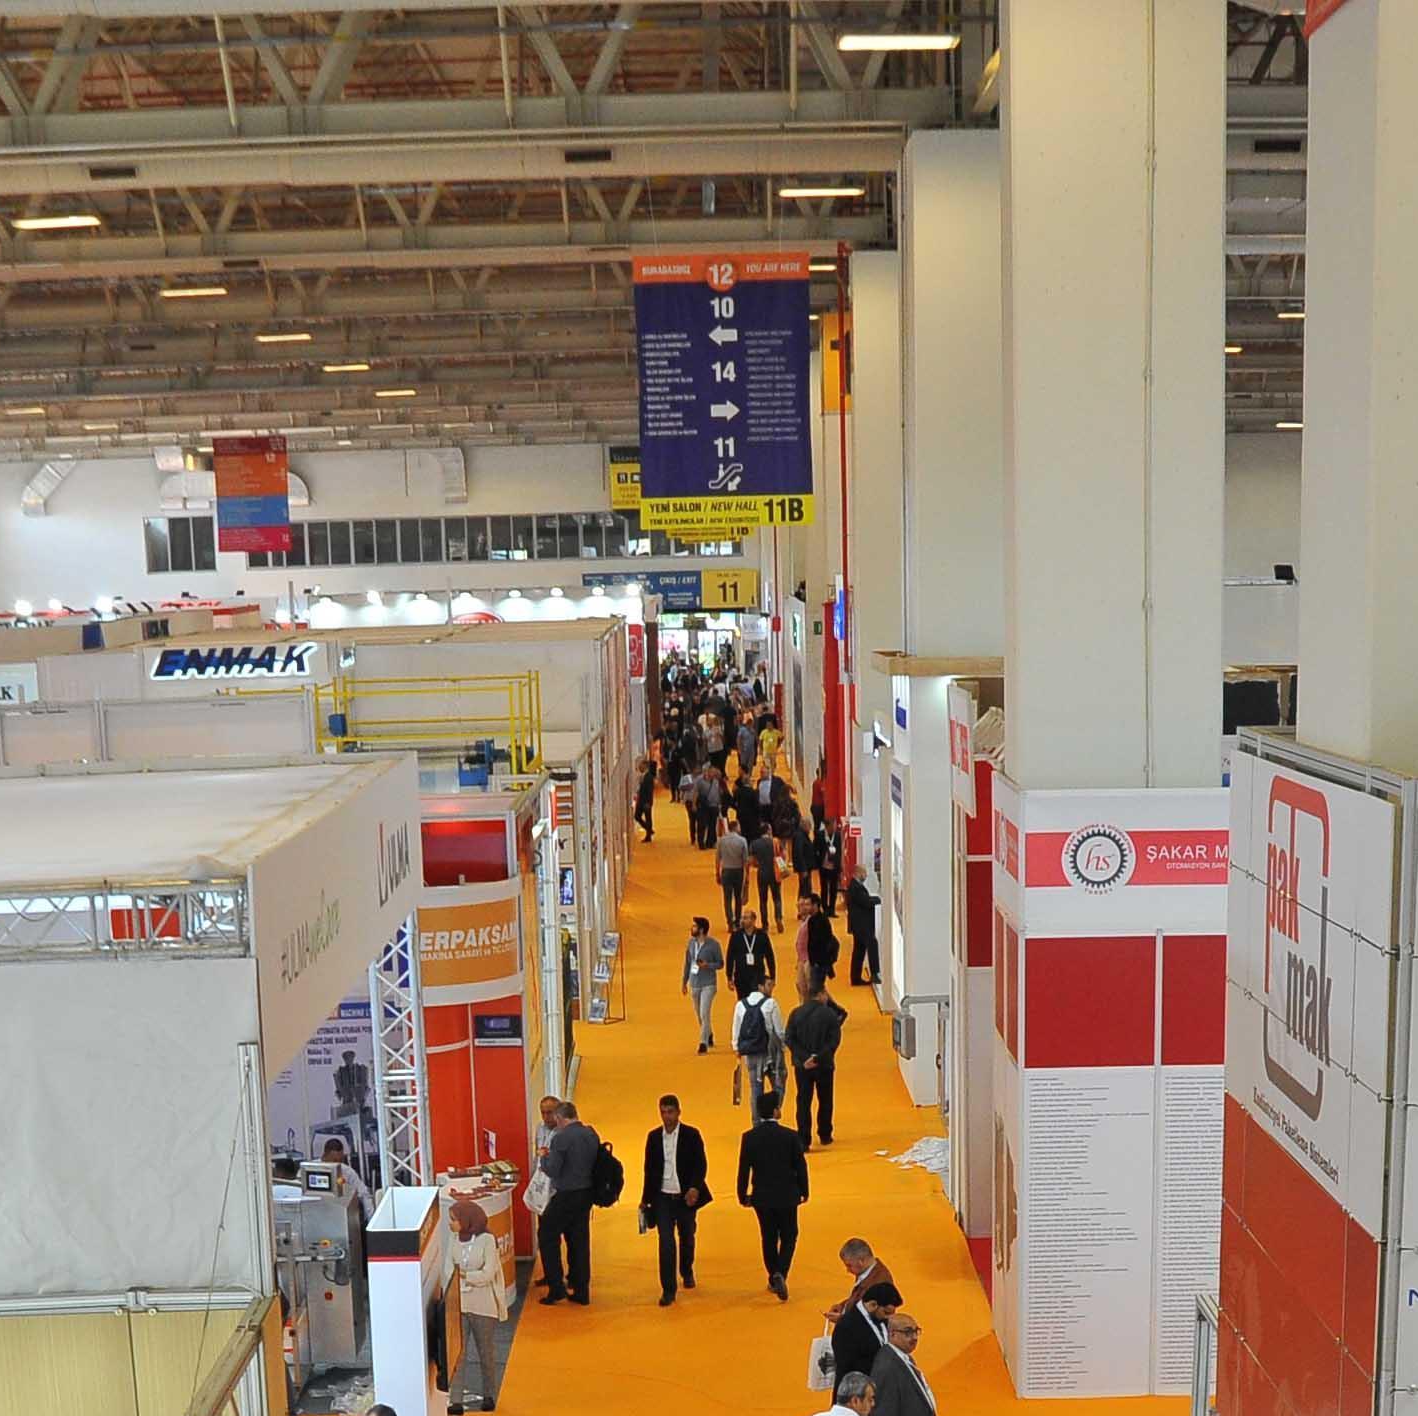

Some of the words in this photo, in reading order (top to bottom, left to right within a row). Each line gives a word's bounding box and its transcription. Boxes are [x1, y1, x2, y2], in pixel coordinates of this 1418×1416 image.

[709, 264, 734, 285] 12
[746, 263, 761, 273] YOU
[763, 263, 780, 273] ARE
[781, 262, 800, 272] HERE
[710, 296, 735, 318] 10
[711, 361, 737, 382] 14
[713, 436, 735, 458] 11
[672, 503, 701, 512] SALON
[710, 503, 732, 512] NEW
[735, 502, 758, 511] HALL
[763, 497, 804, 523] 11B
[718, 582, 739, 602] 11
[152, 642, 318, 681] ENMAK
[1146, 845, 1207, 863] ŞAKAR
[1267, 825, 1300, 965] pak
[1286, 915, 1332, 1067] mak
